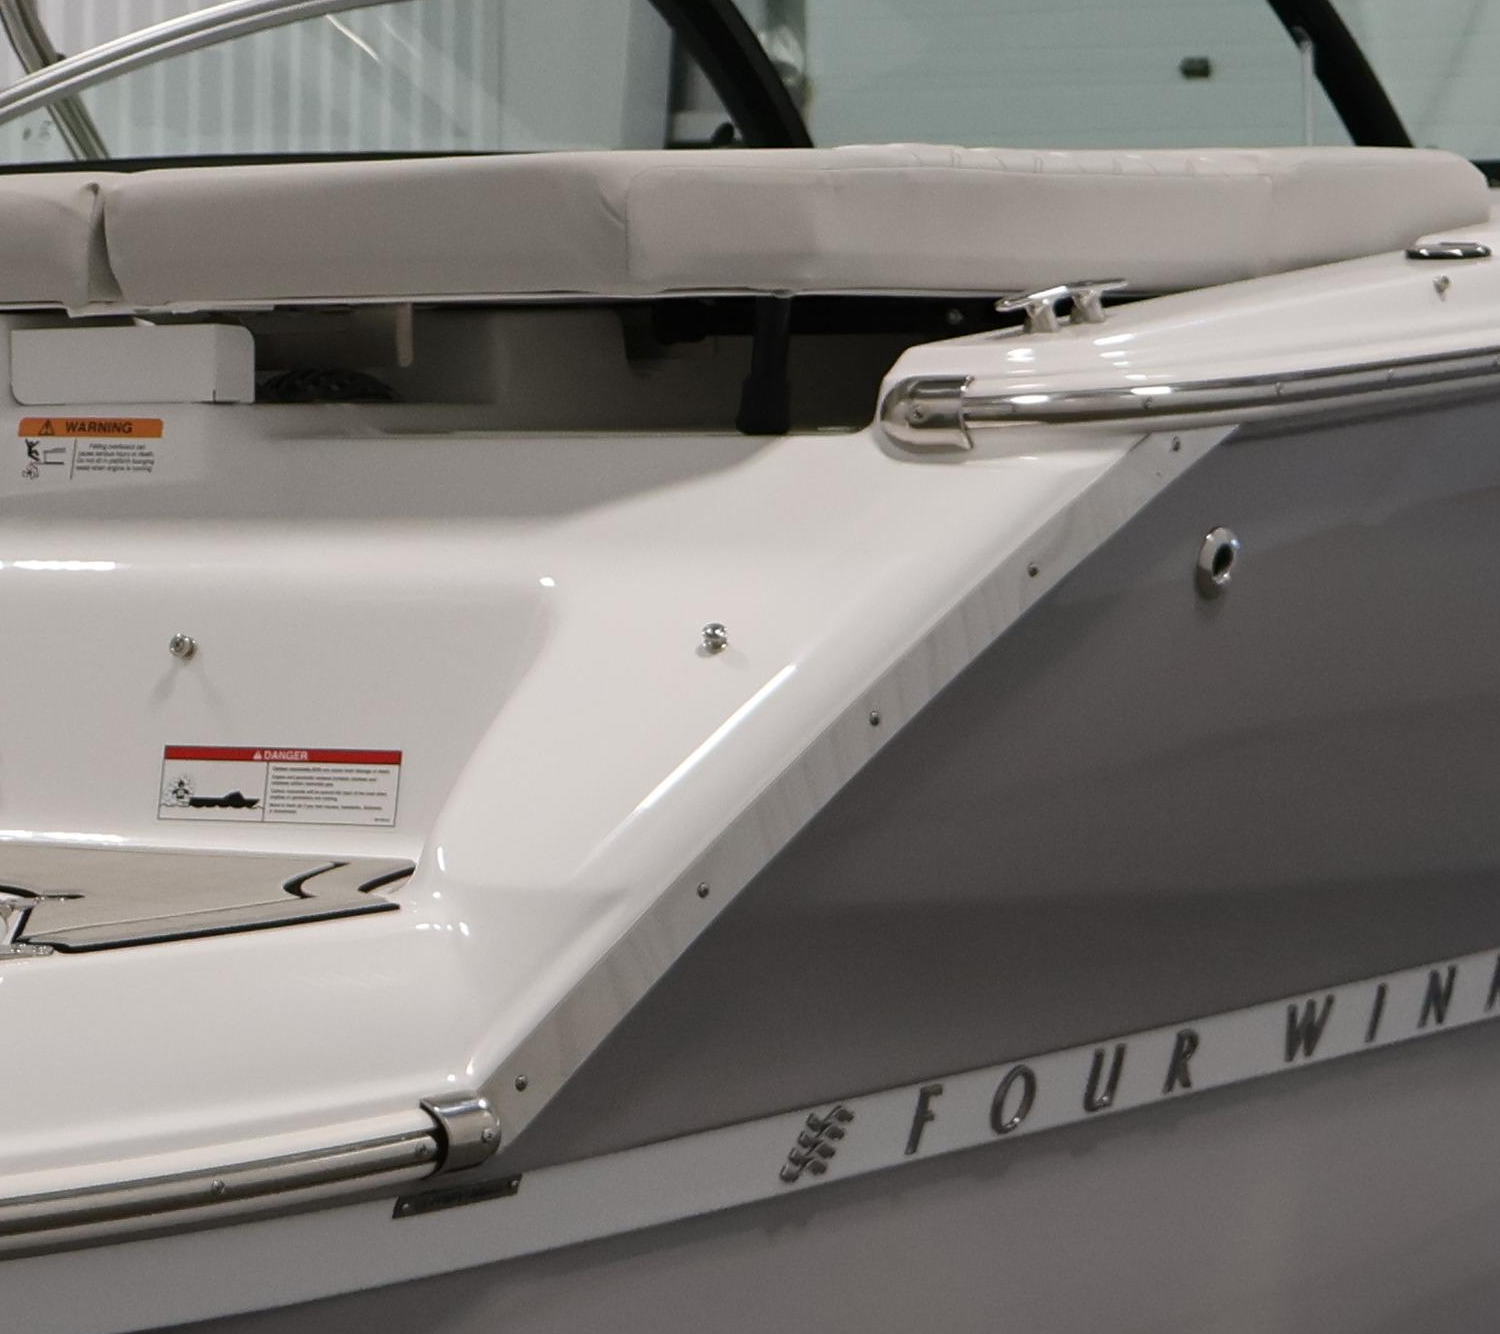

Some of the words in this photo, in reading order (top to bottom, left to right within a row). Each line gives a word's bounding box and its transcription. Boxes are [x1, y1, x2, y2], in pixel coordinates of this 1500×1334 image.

[65, 421, 133, 434] WARNING
[263, 750, 309, 761] DANGER
[904, 1028, 1199, 1156] FOUR
